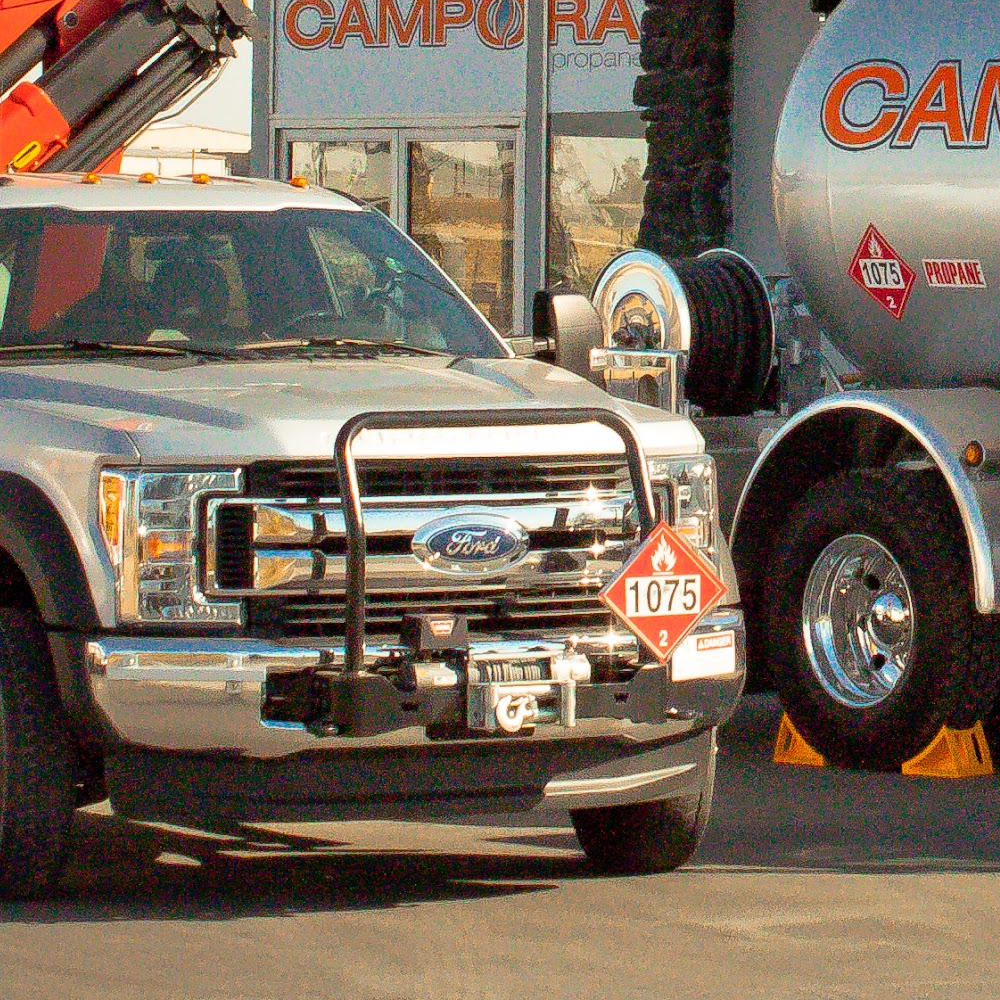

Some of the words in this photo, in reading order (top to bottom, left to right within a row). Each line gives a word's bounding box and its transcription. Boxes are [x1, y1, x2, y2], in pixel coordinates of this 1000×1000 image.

[862, 261, 902, 286] 1075
[924, 260, 984, 286] PROPANE
[885, 295, 898, 309] 2
[446, 529, 502, 557] Ford
[629, 578, 697, 613] 1075
[658, 629, 669, 647] 2
